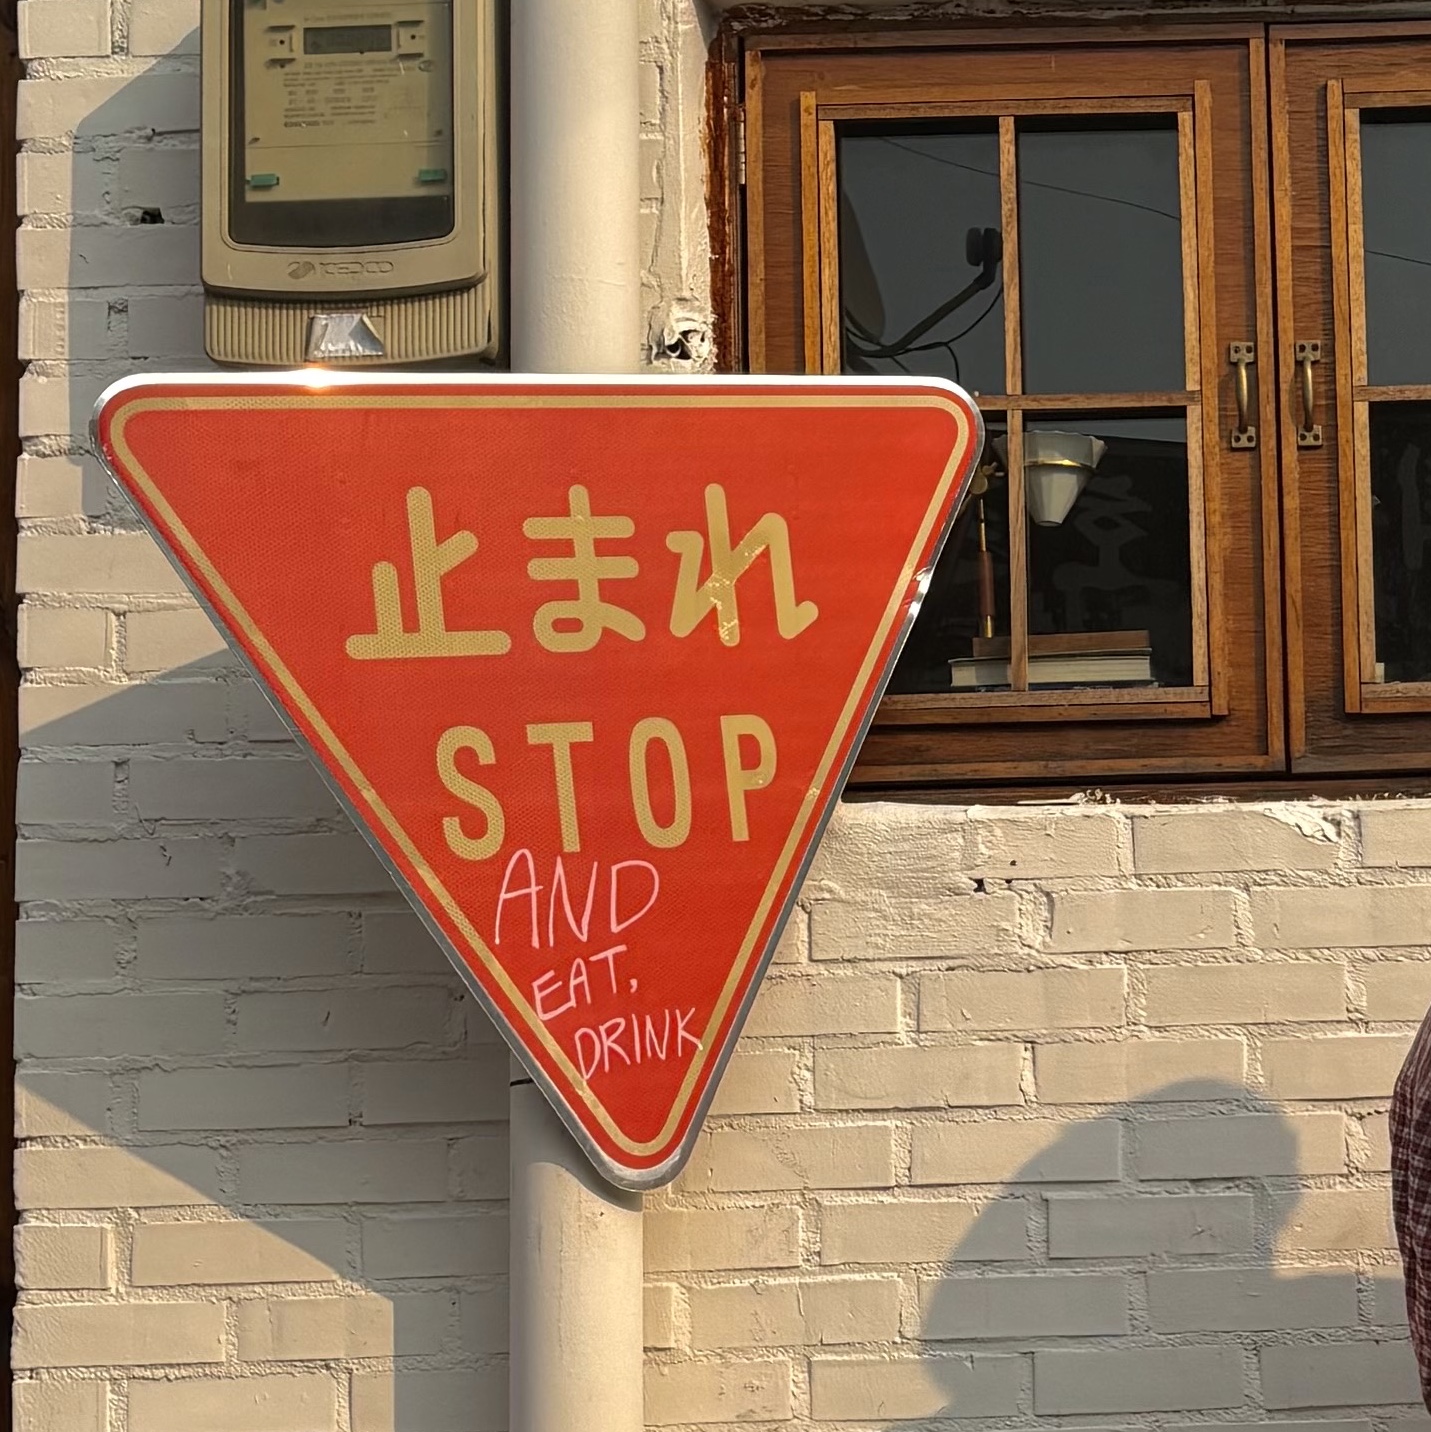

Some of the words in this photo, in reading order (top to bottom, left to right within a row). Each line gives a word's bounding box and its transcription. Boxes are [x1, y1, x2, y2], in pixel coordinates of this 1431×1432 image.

[345, 483, 819, 660] 止まれ
[436, 714, 778, 861] STOP
[495, 848, 660, 949] AND
[532, 944, 638, 1021] EAT,
[574, 1007, 704, 1082] DRINK
